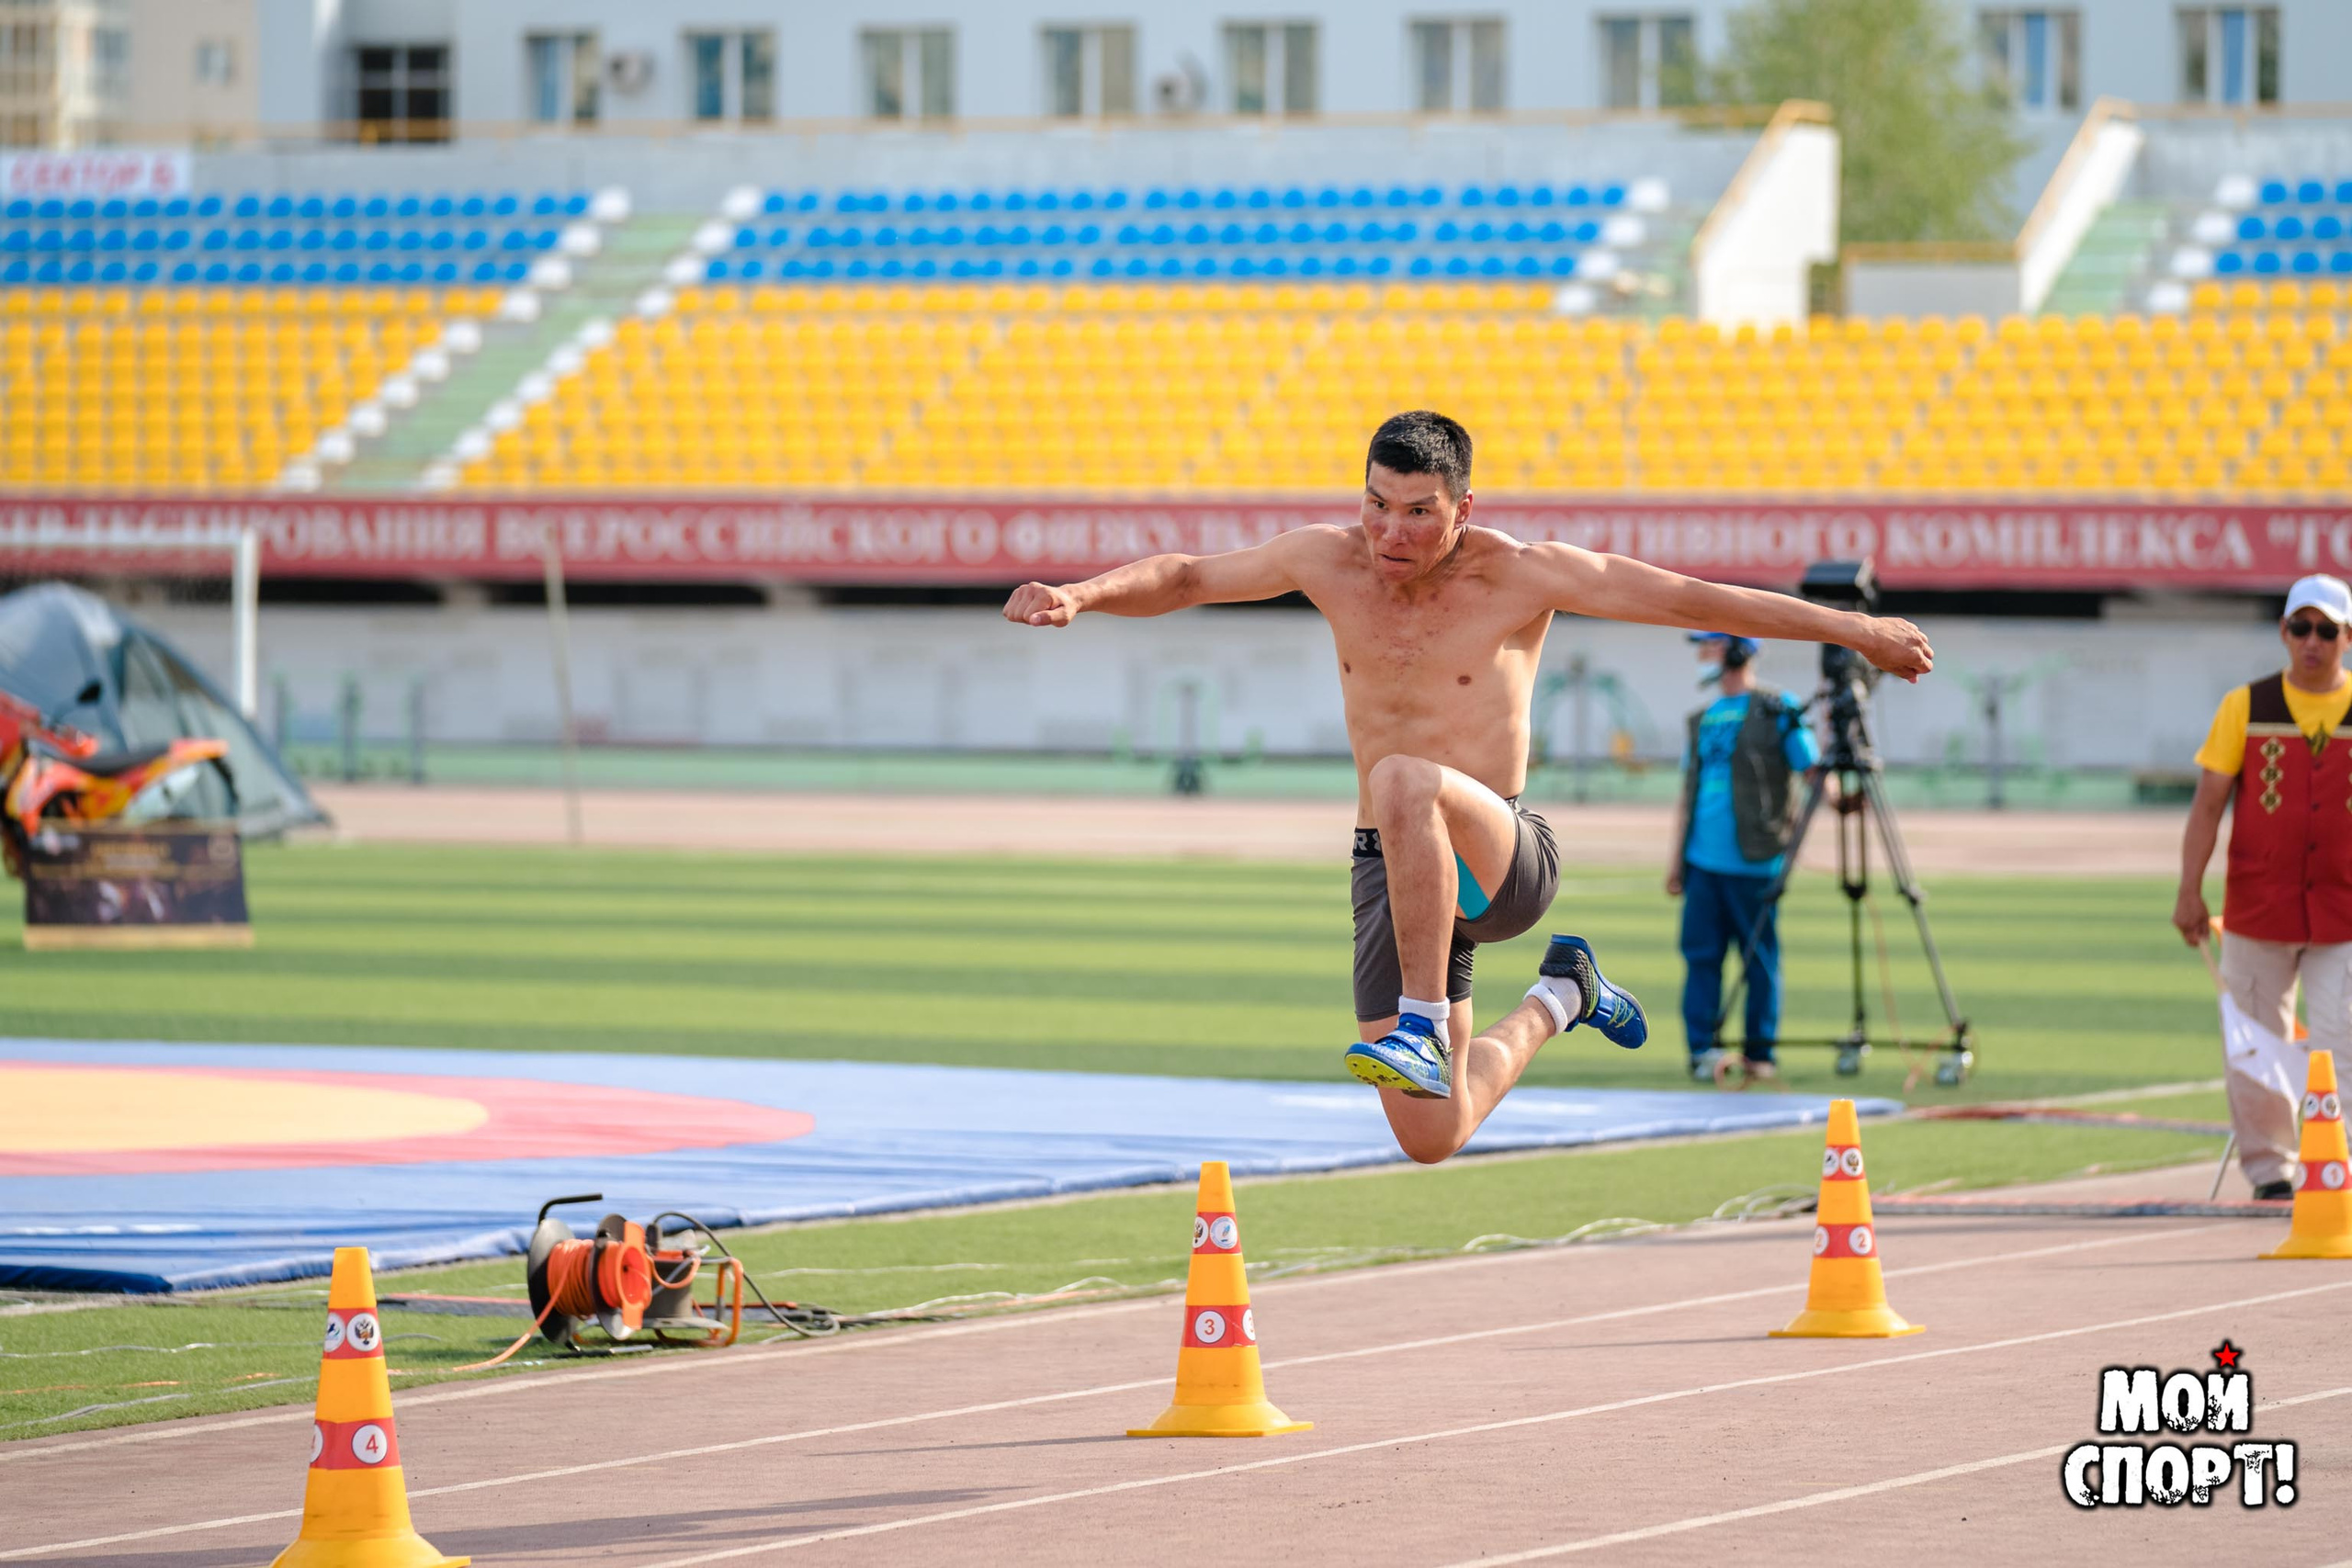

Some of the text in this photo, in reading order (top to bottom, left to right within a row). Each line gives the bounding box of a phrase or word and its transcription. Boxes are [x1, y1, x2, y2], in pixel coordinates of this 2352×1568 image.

[1885, 510, 2256, 569] КОМПЛЕКСА
[1858, 1233, 1867, 1247] 2
[1204, 1318, 1215, 1336] 3
[366, 1434, 379, 1453] 4
